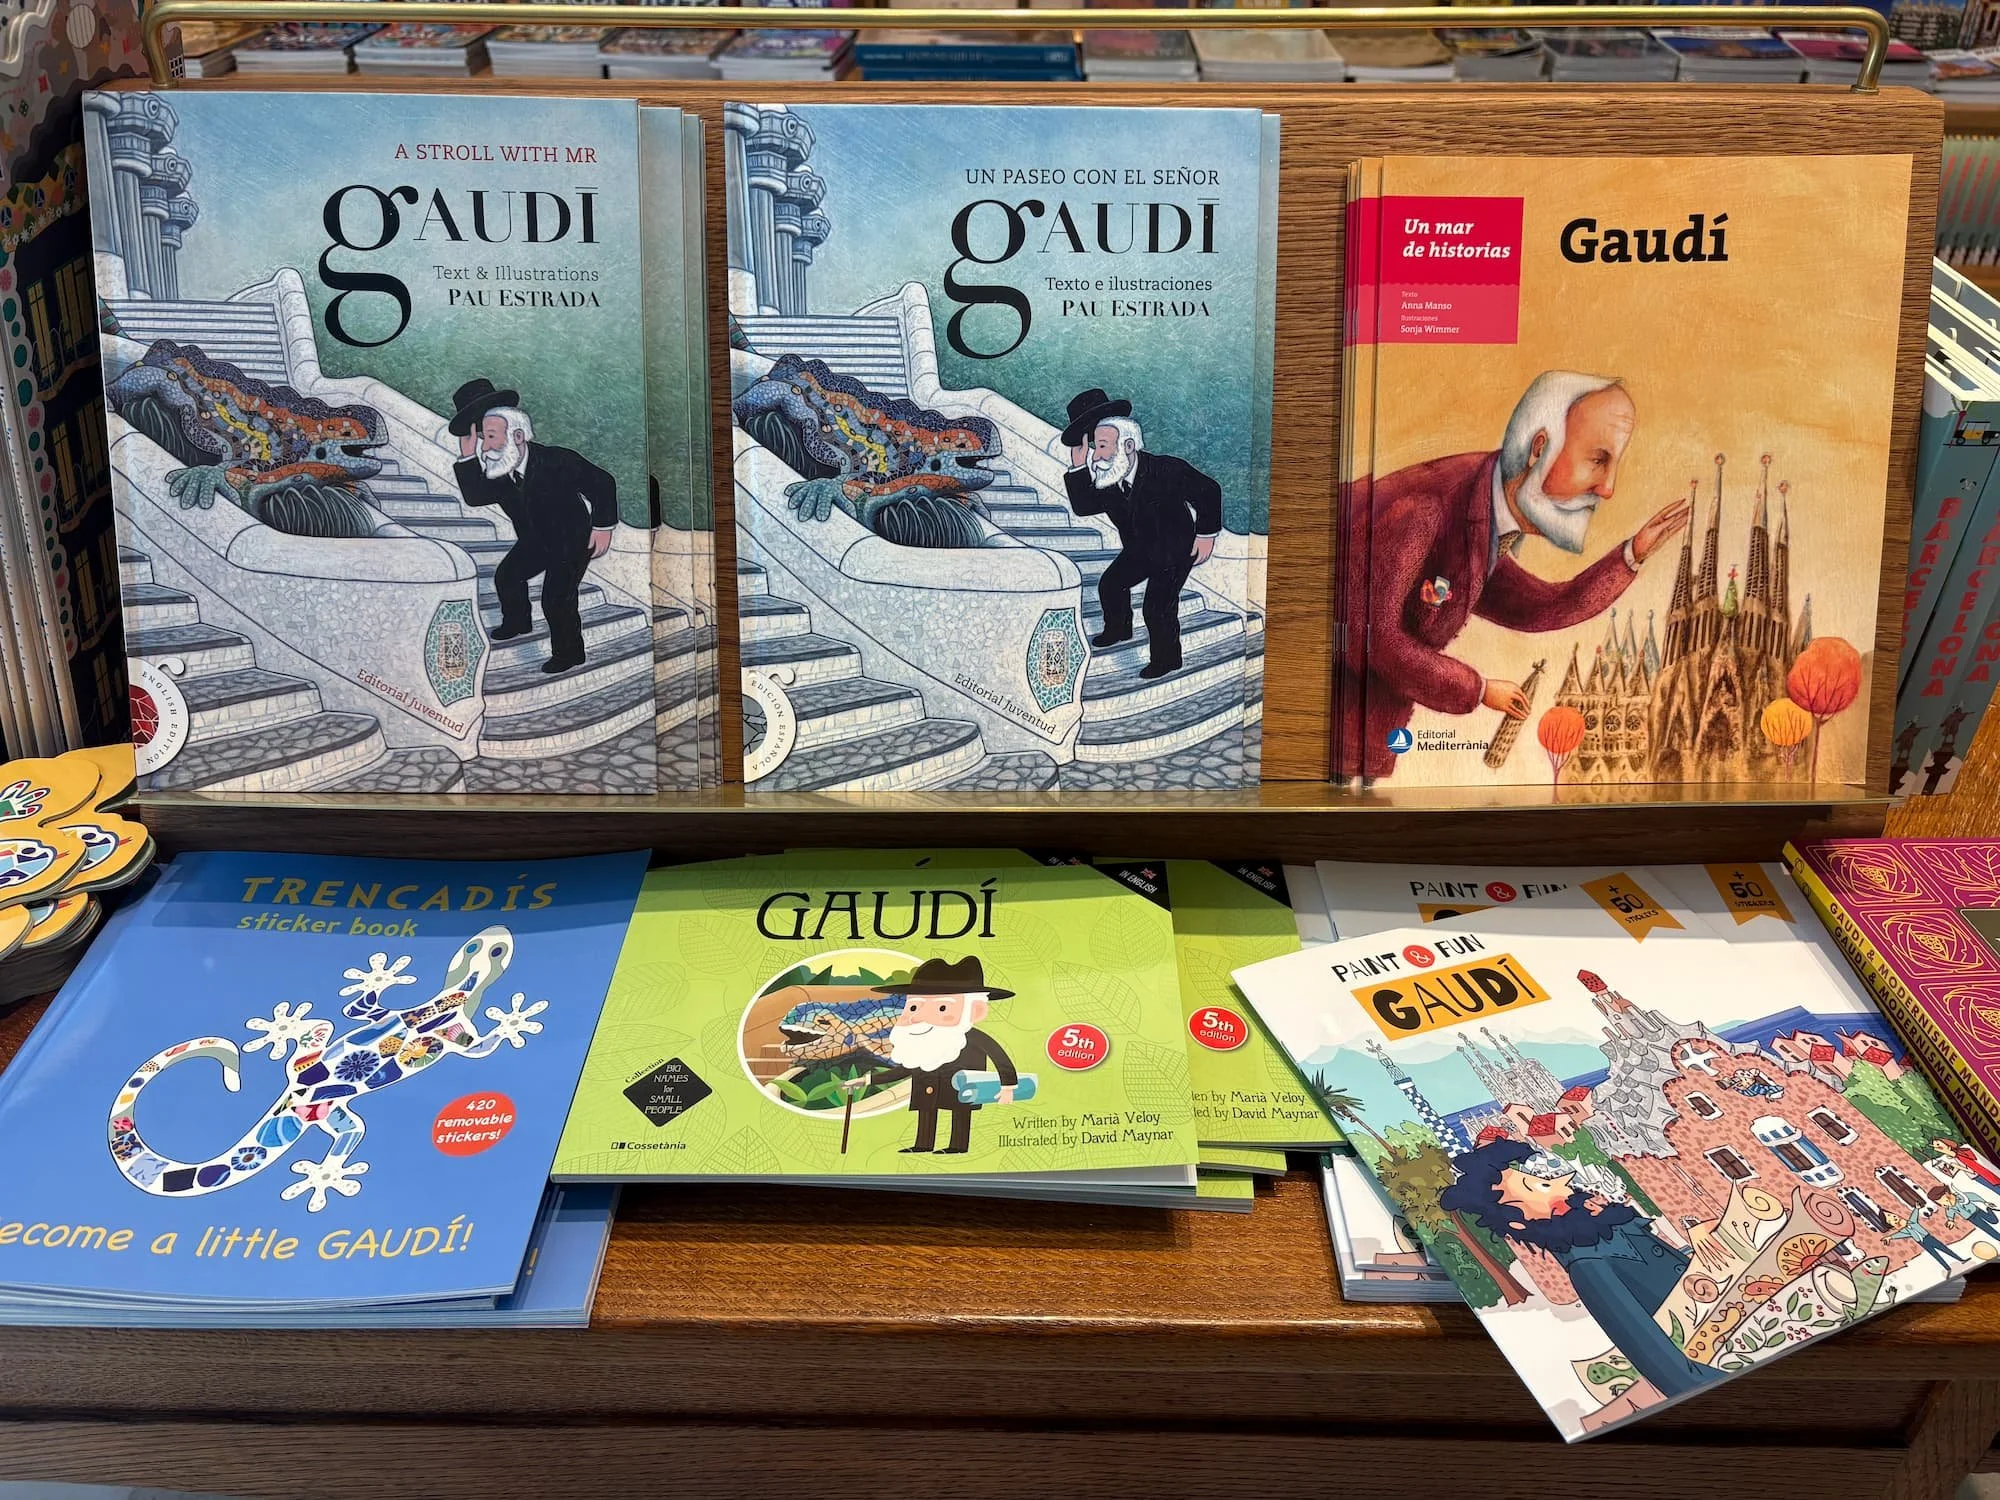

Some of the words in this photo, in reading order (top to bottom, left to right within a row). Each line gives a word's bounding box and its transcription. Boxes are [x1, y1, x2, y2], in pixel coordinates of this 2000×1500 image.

[394, 144, 409, 160] A
[417, 145, 494, 162] STROLL
[500, 146, 558, 163] WITH
[565, 147, 597, 164] MR
[966, 169, 995, 185] UN
[1003, 169, 1066, 185] PASEO
[1073, 169, 1117, 185] CON
[1124, 169, 1146, 185] EL
[1153, 166, 1220, 186] SEÑOR
[1404, 218, 1429, 235] Un
[1435, 221, 1474, 236] mar
[1560, 213, 1729, 264] Gaudí
[1402, 241, 1425, 258] de
[1429, 241, 1511, 260] historias
[433, 265, 469, 280] Text
[477, 266, 488, 280] &
[495, 265, 599, 281] Illustrations
[1045, 276, 1090, 292] Texto
[1095, 280, 1103, 291] e
[1109, 276, 1213, 291] ilustraciones
[449, 288, 491, 307] PAU
[500, 288, 600, 308] ESTRADA
[1401, 290, 1418, 298] Texto
[1062, 300, 1104, 317] PAU
[1112, 300, 1210, 318] ESTRADA
[1401, 301, 1423, 310] Anna
[1424, 301, 1452, 310] Manso
[1400, 325, 1422, 336] Sonja
[1424, 325, 1460, 334] Wimmer
[142, 671, 177, 715] ENGLISH
[356, 668, 408, 704] Editorial
[409, 698, 465, 735] Juventud
[953, 672, 1003, 707] Editorial
[1003, 698, 1058, 736] Juventud
[1417, 729, 1456, 739] Editorial
[146, 724, 178, 764] EDITION
[1417, 740, 1489, 751] Mediterrània
[1119, 870, 1129, 879] IN
[1127, 875, 1158, 894] ENGLISH
[1237, 867, 1248, 876] IN
[1246, 872, 1277, 890] ENGLISH
[241, 873, 557, 912] TRENCADÍS
[1409, 881, 1479, 899] PAINT
[1492, 885, 1512, 899] &
[1728, 881, 1763, 899] 50
[756, 877, 999, 940] GAUDÍ
[1610, 893, 1645, 914] 50
[237, 912, 342, 935] sticker
[349, 917, 418, 938] book
[1625, 909, 1659, 924] STICKERS
[1331, 952, 1400, 983] PAINT
[1409, 950, 1431, 964] &
[1434, 933, 1486, 958] FUN
[1372, 957, 1536, 1030] GAUDÍ
[1867, 951, 1876, 963] &
[1878, 963, 1958, 1066] MODERNISME
[1202, 1011, 1235, 1033] 5th
[1867, 972, 1876, 985] &
[1879, 986, 1954, 1085] MODERNISME
[1061, 1028, 1096, 1051] 5th
[1200, 1029, 1236, 1044] edition
[1057, 1048, 1096, 1062] edition
[625, 1058, 664, 1083] Collection
[666, 1064, 682, 1073] BIG
[654, 1075, 689, 1083] NAMES
[663, 1085, 675, 1093] for
[1212, 1091, 1226, 1105] by
[1231, 1091, 1267, 1103] Marià
[1271, 1091, 1305, 1106] Veloy
[466, 1099, 496, 1111] 420
[649, 1095, 682, 1104] SMALL
[644, 1105, 682, 1114] PEOPLE
[1214, 1106, 1229, 1122] by
[1232, 1107, 1267, 1119] David
[1271, 1107, 1320, 1122] Maynar
[437, 1113, 513, 1128] removable
[1012, 1117, 1057, 1129] Written
[1062, 1115, 1077, 1130] by
[1081, 1112, 1120, 1127] Marià
[1125, 1110, 1161, 1126] Veloy
[436, 1129, 501, 1144] stickers!
[998, 1133, 1057, 1148] Illustrated
[1062, 1132, 1078, 1148] by
[1081, 1130, 1117, 1145] David
[1122, 1128, 1174, 1145] Maynar
[0, 1219, 134, 1253] ecome
[151, 1230, 178, 1255] a
[195, 1225, 299, 1261] little
[318, 1215, 474, 1260] GAUDÍ!
